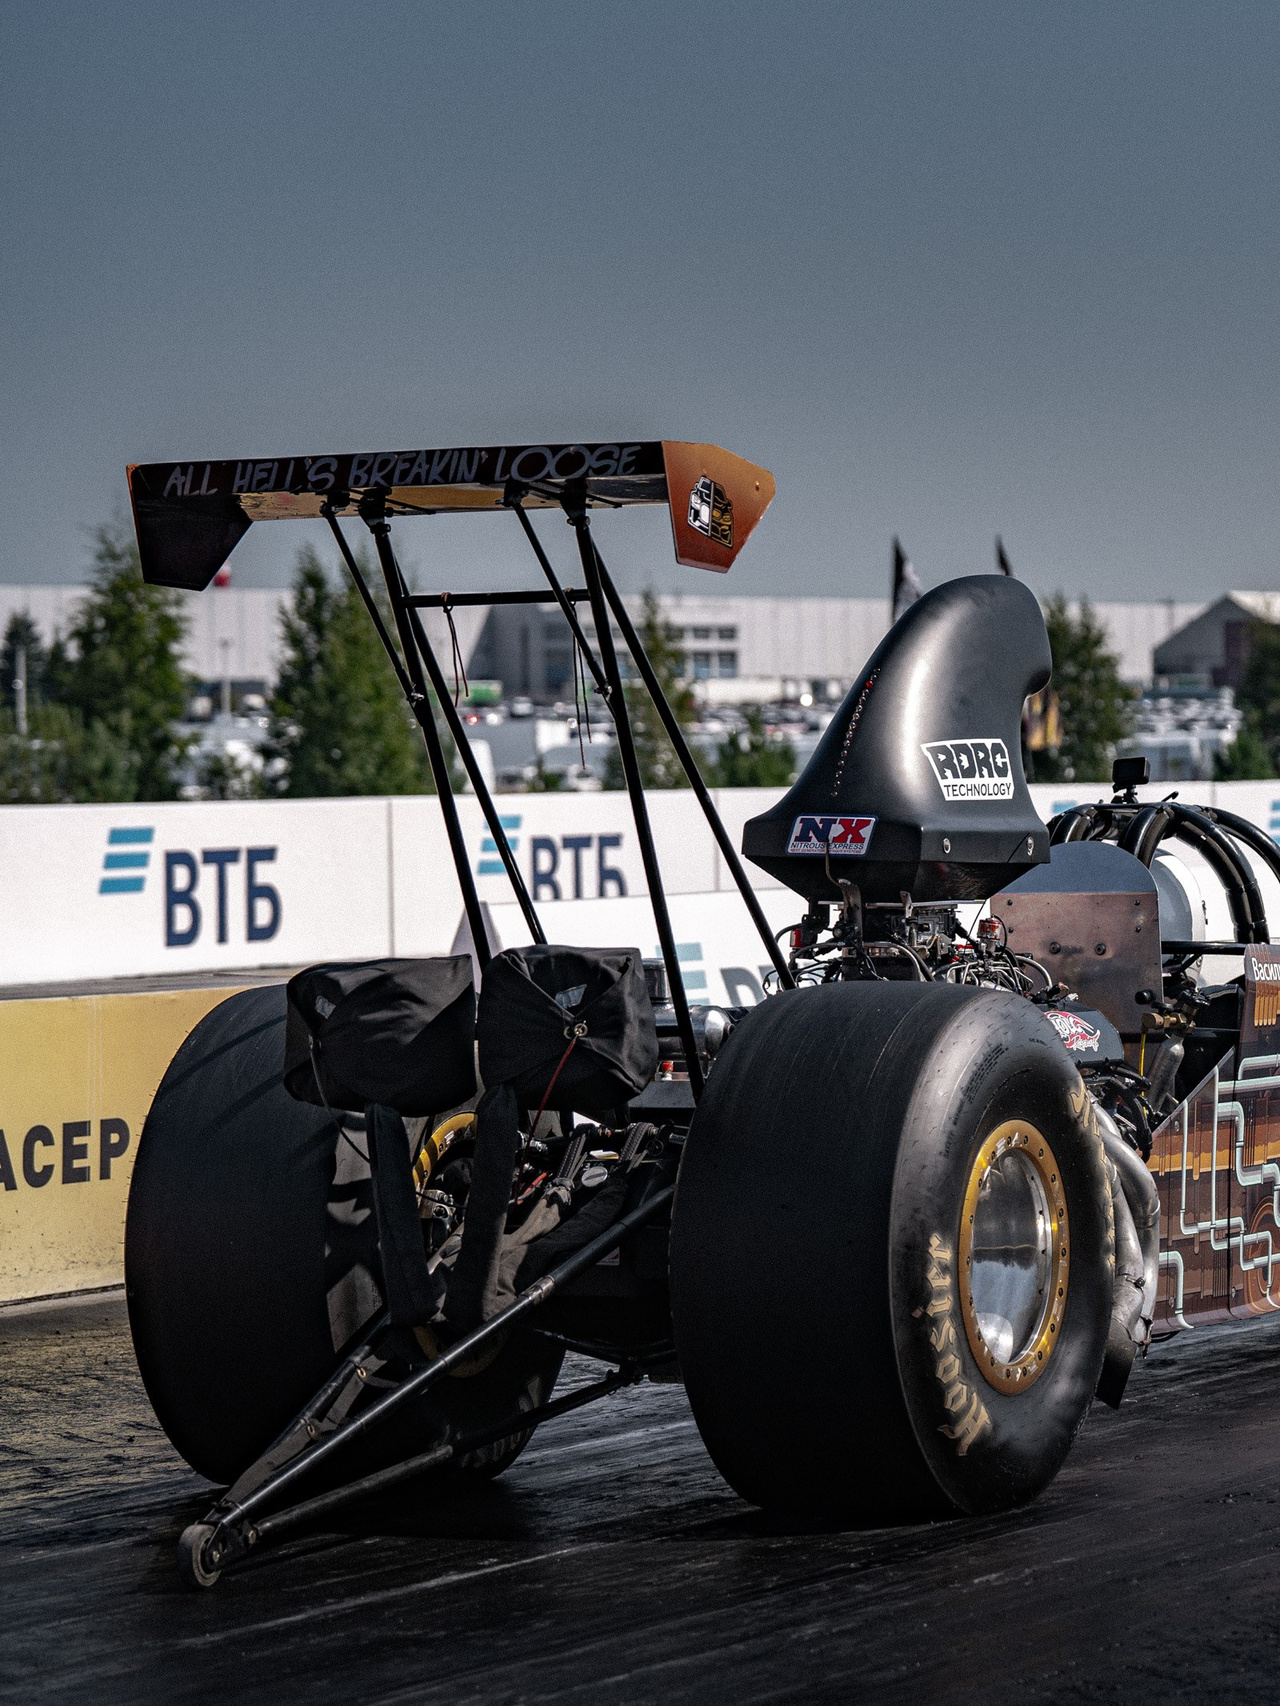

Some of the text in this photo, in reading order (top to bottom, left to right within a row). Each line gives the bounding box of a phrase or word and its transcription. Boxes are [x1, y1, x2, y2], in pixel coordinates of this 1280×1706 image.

[163, 445, 641, 498] ALL HELL'S BREAKIN' LOOSE
[926, 742, 1009, 780] RDRC
[943, 782, 1011, 797] TECHNOLOGY
[791, 842, 826, 850] NITROUS
[794, 817, 872, 843] NX
[165, 846, 282, 947] ВТБ
